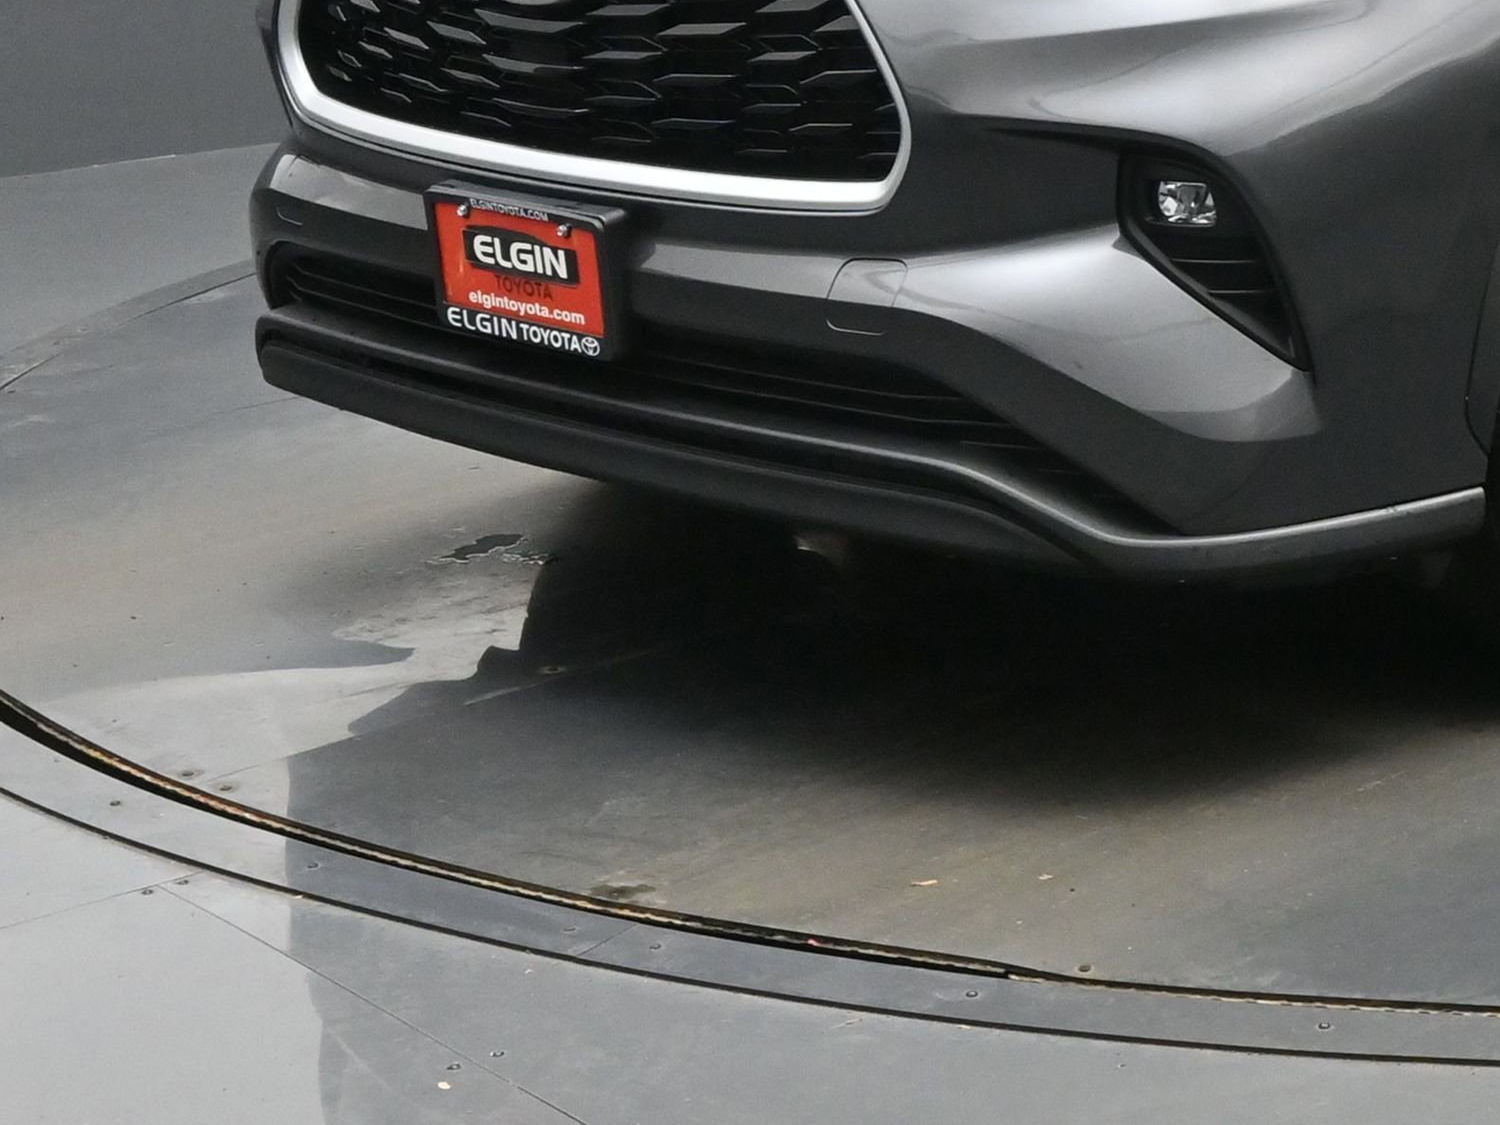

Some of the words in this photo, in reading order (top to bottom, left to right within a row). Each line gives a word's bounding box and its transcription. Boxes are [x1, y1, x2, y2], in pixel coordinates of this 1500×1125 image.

[469, 198, 549, 222] ELGINTOYOTA.COM
[473, 234, 568, 279] ELGIN
[495, 275, 553, 300] TOYOTA
[468, 290, 585, 325] elgintoyota.com
